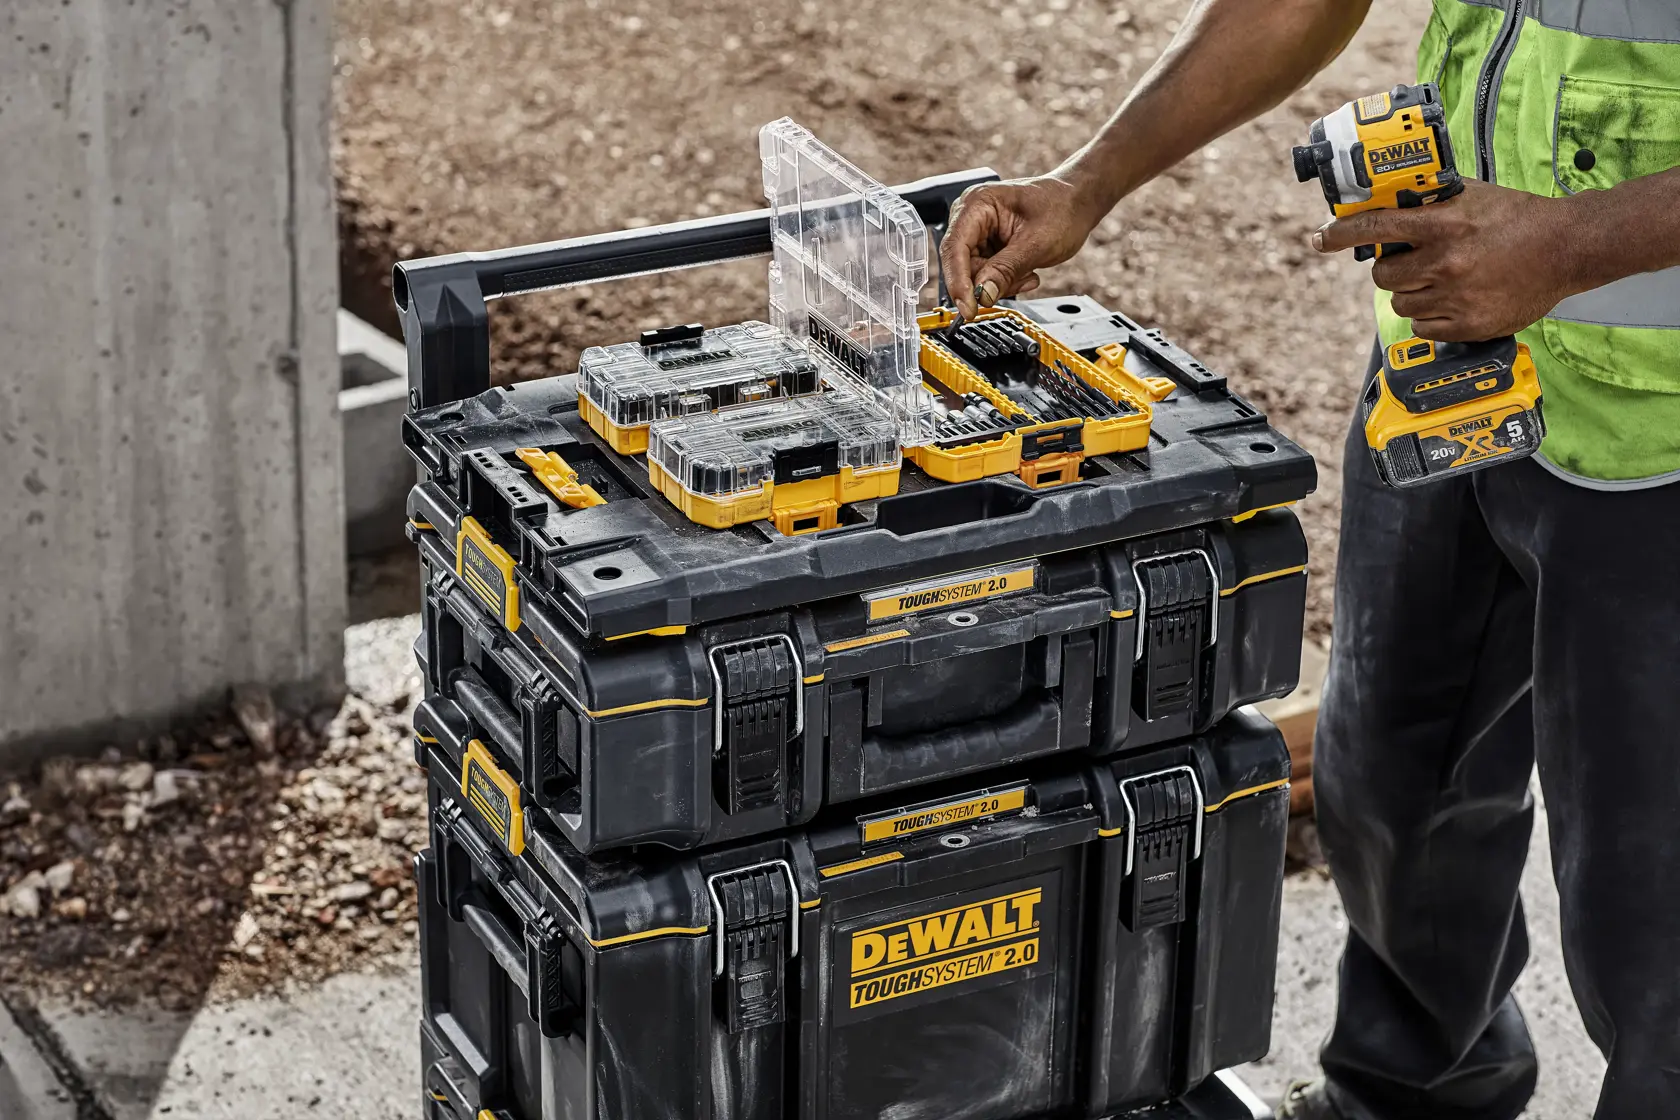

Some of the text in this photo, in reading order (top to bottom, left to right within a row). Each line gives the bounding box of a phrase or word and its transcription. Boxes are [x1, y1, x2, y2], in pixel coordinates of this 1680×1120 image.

[1368, 138, 1430, 164] DEWALT
[808, 312, 867, 380] DEWALT
[658, 350, 734, 371] DEWALT
[1448, 416, 1494, 437] DEWALT
[1506, 420, 1523, 438] 5
[1510, 435, 1526, 444] AH
[988, 577, 1007, 592] 2.0
[980, 799, 999, 813] 2.0
[1003, 943, 1036, 967] 2.0
